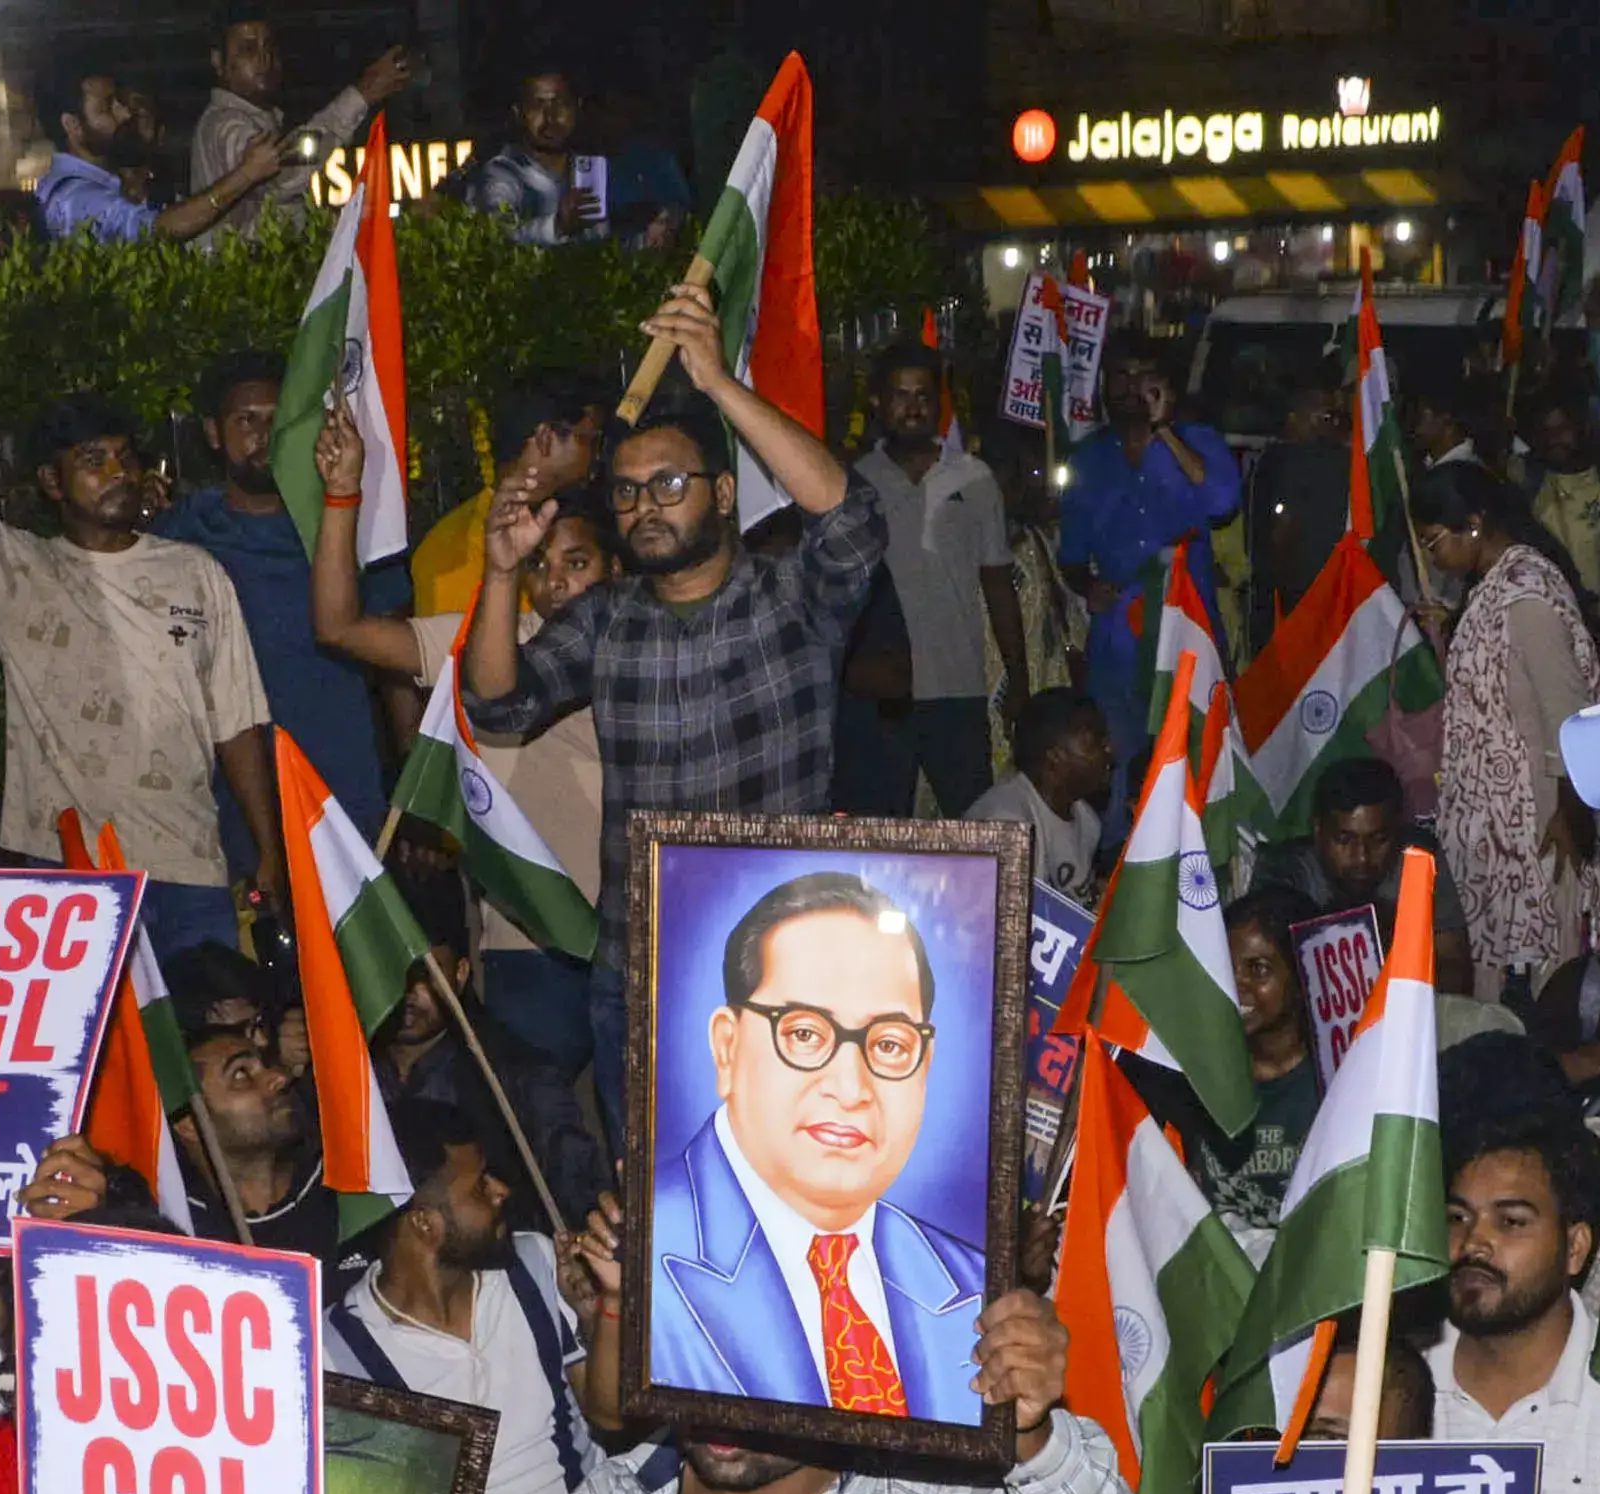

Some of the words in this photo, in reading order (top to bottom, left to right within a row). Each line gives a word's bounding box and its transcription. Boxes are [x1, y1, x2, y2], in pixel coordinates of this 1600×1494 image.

[1068, 109, 1263, 165] Jalajoga
[1313, 931, 1374, 1023] JSSC
[55, 1274, 275, 1447] JSSC
